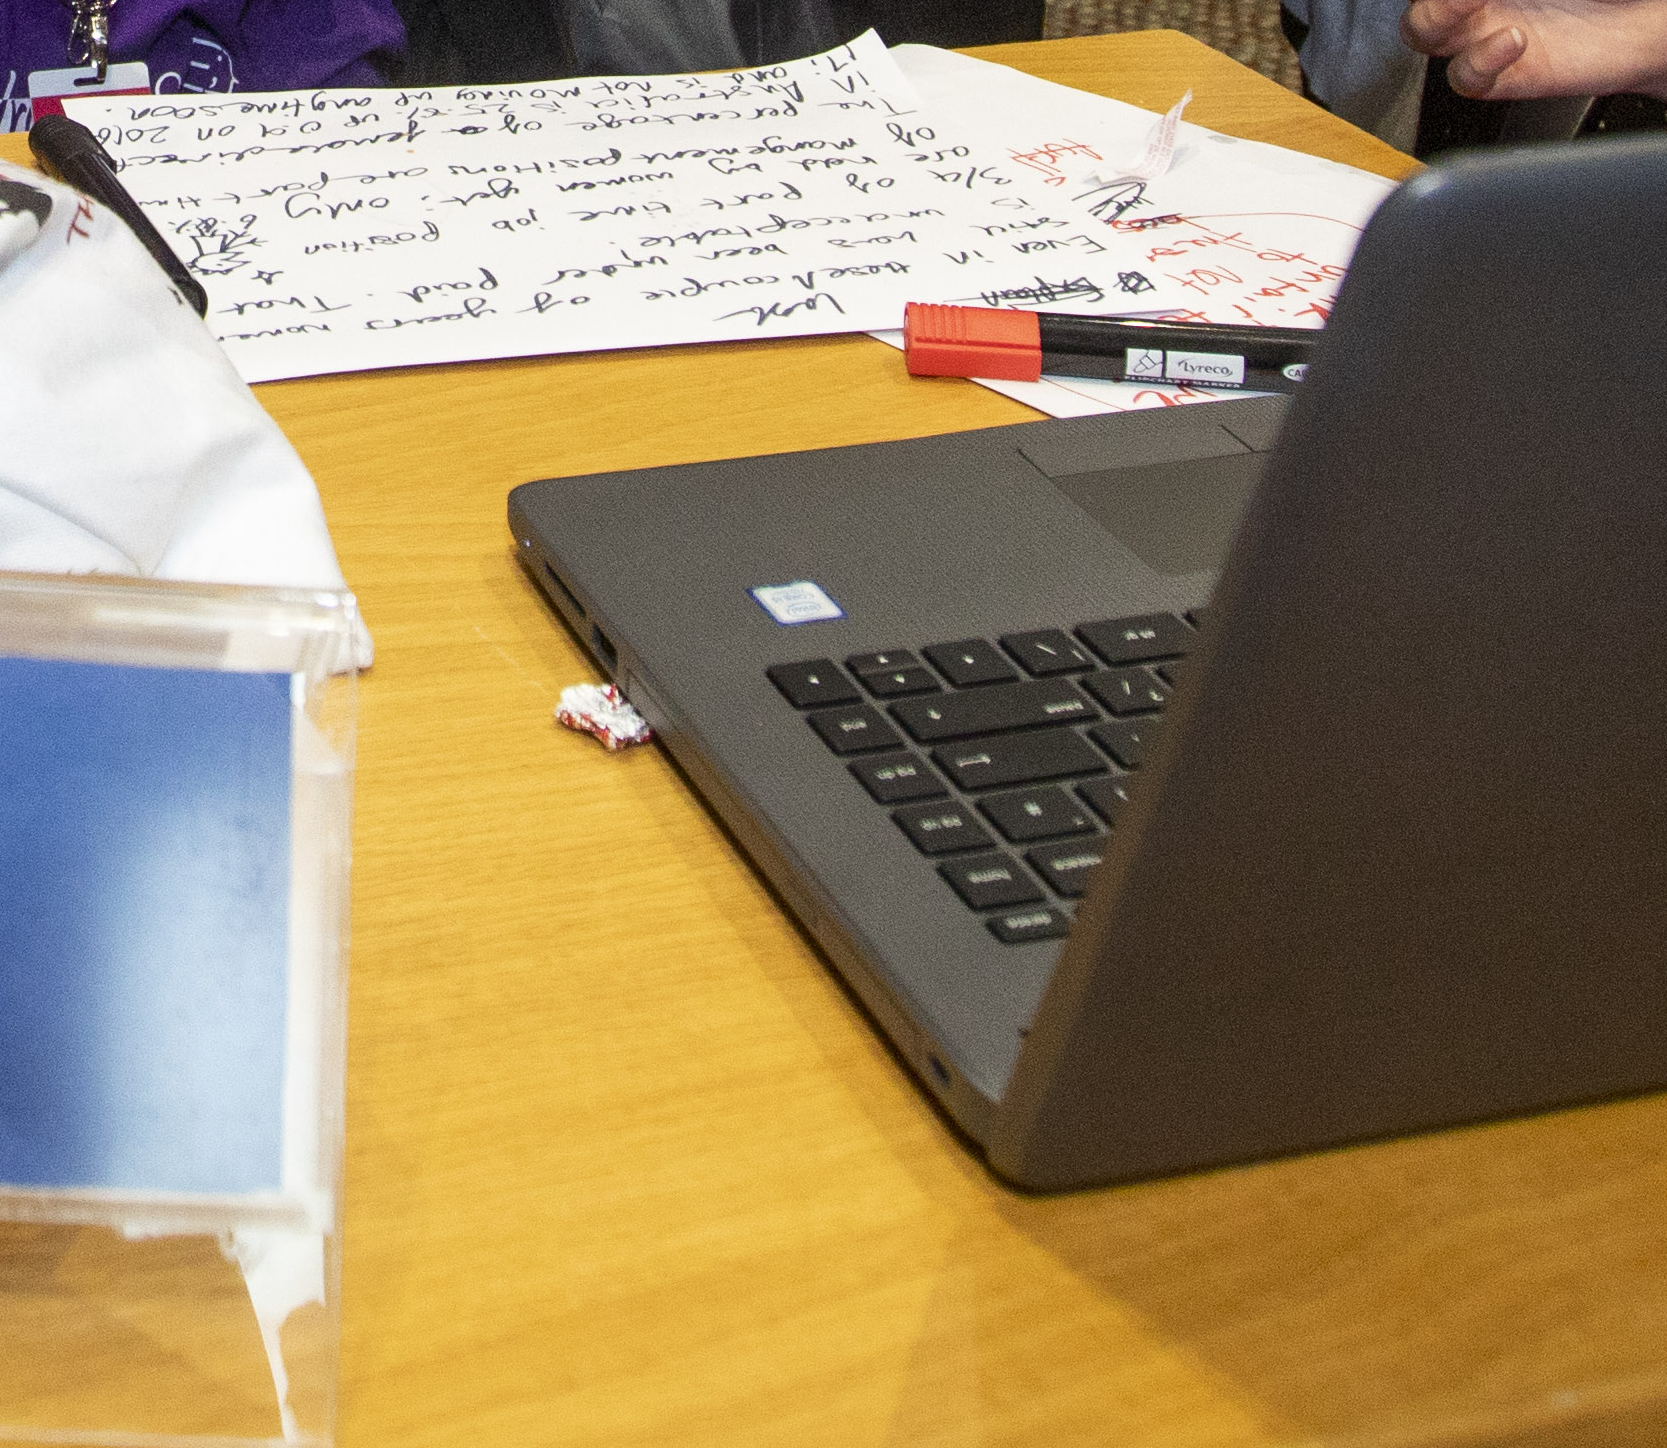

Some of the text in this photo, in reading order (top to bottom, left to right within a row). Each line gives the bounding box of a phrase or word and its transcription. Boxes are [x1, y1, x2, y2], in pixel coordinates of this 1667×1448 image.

[588, 80, 653, 97] not
[829, 71, 871, 95] in
[392, 89, 433, 107] up
[816, 100, 919, 119] The
[196, 125, 236, 143] on
[885, 123, 937, 147] of
[448, 149, 622, 177] positions
[903, 144, 970, 165] are
[345, 166, 429, 185] are
[555, 170, 675, 194] women
[223, 170, 330, 205] part
[282, 197, 391, 220] only
[303, 167, 1012, 258] 3/4 of part time job position
[694, 243, 788, 261] been
[1012, 234, 1106, 254] Even
[942, 248, 994, 266] in
[644, 273, 780, 303] couple
[216, 294, 351, 316] That
[363, 297, 497, 332] years
[1183, 359, 1230, 375] Lyreco
